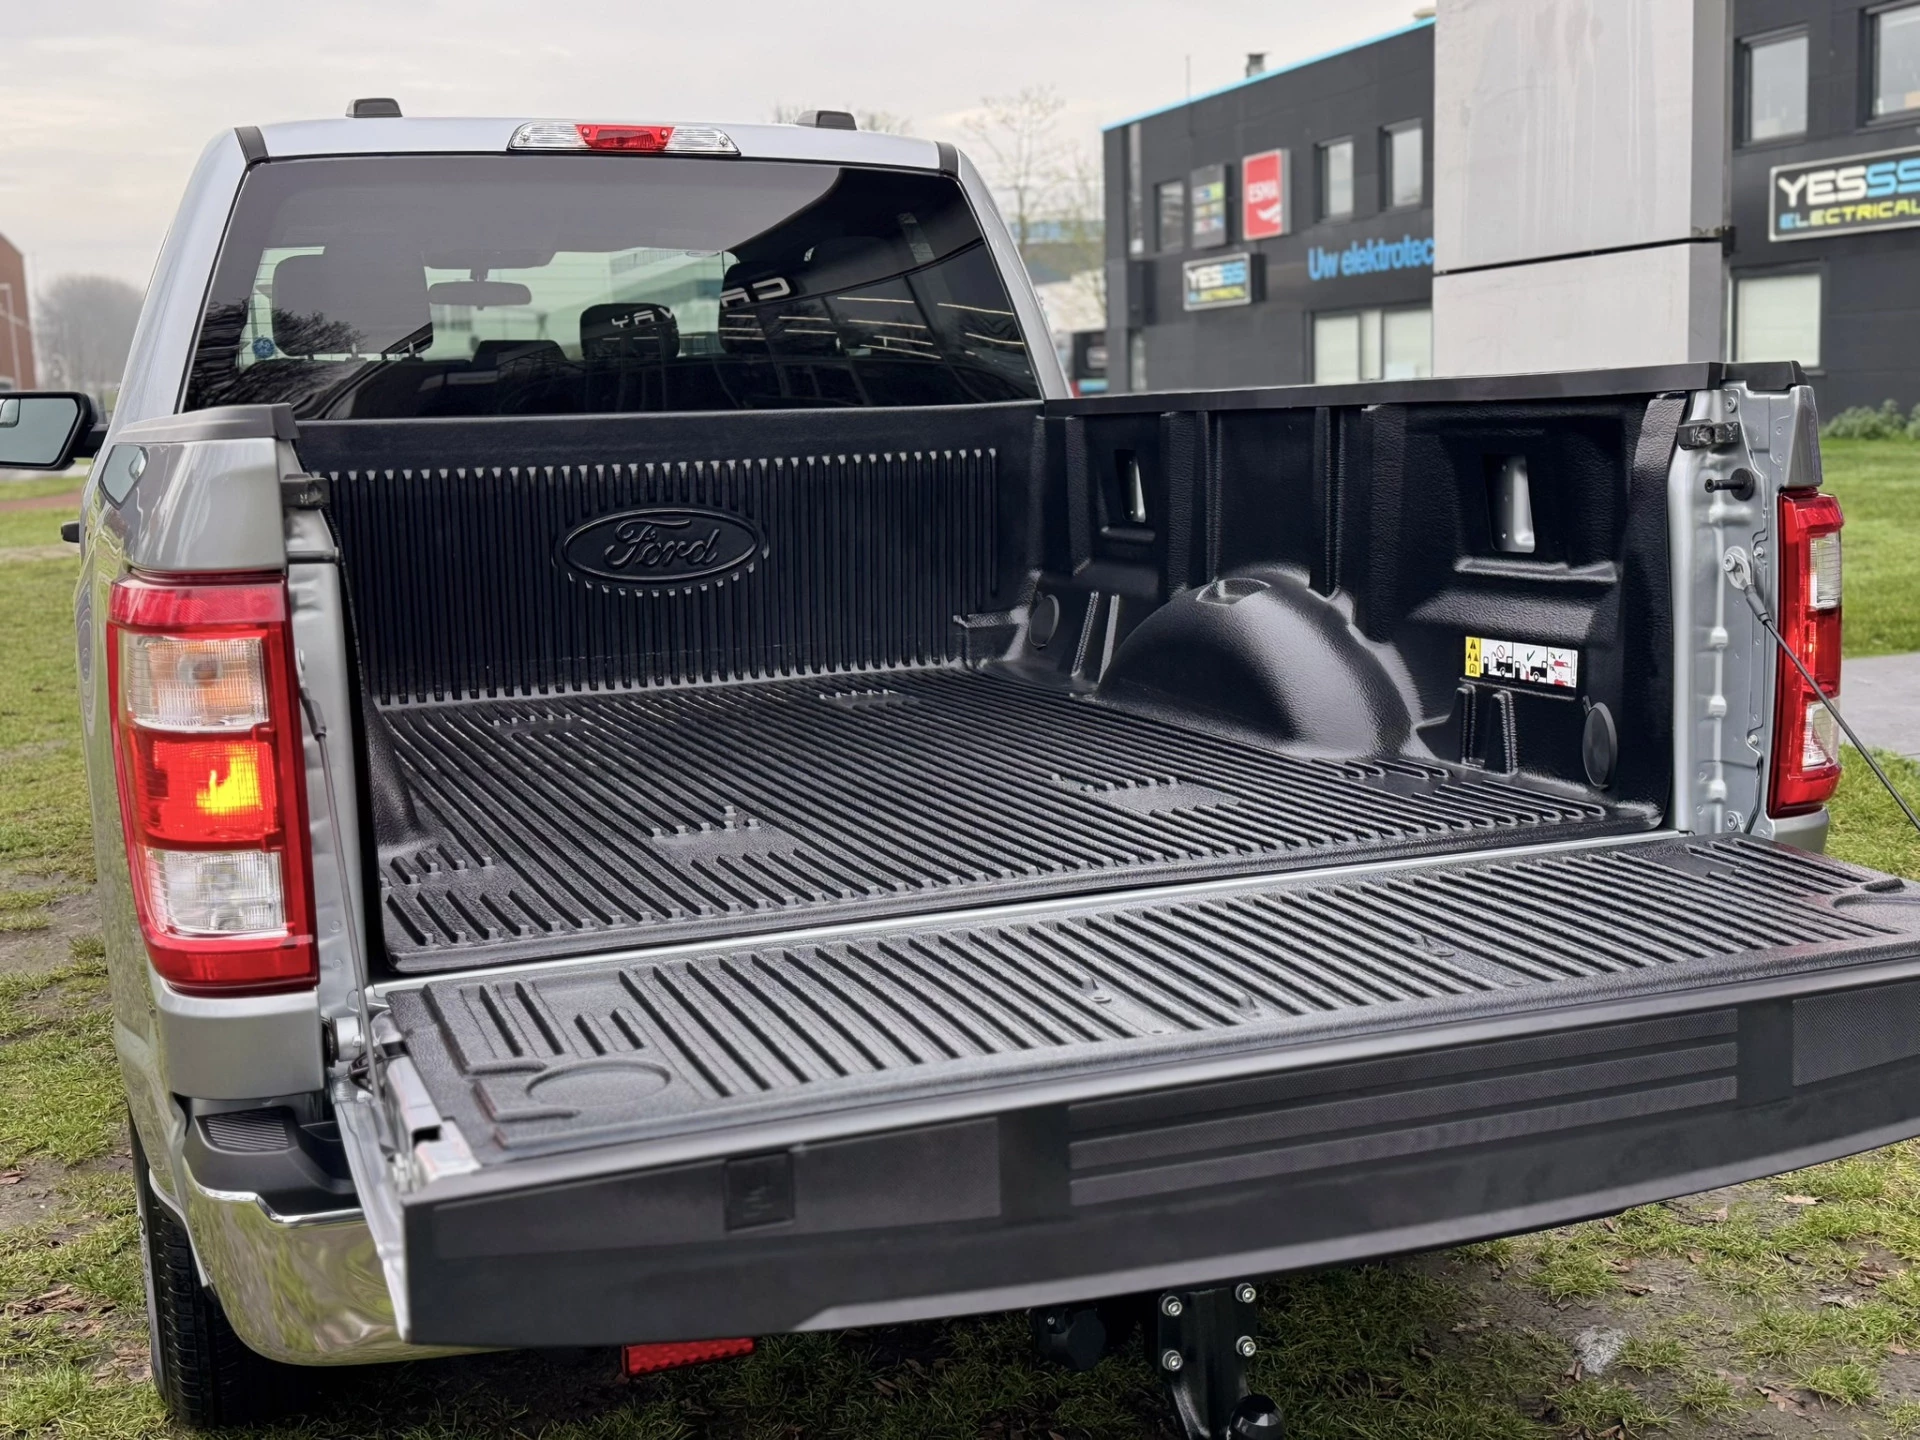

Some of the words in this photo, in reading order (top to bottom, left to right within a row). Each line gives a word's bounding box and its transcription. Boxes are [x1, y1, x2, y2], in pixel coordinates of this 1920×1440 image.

[1777, 157, 1920, 208] YESSS
[1779, 199, 1920, 229] ELECTRICAL
[1308, 245, 1338, 280] Uw
[604, 518, 720, 567] Ford
